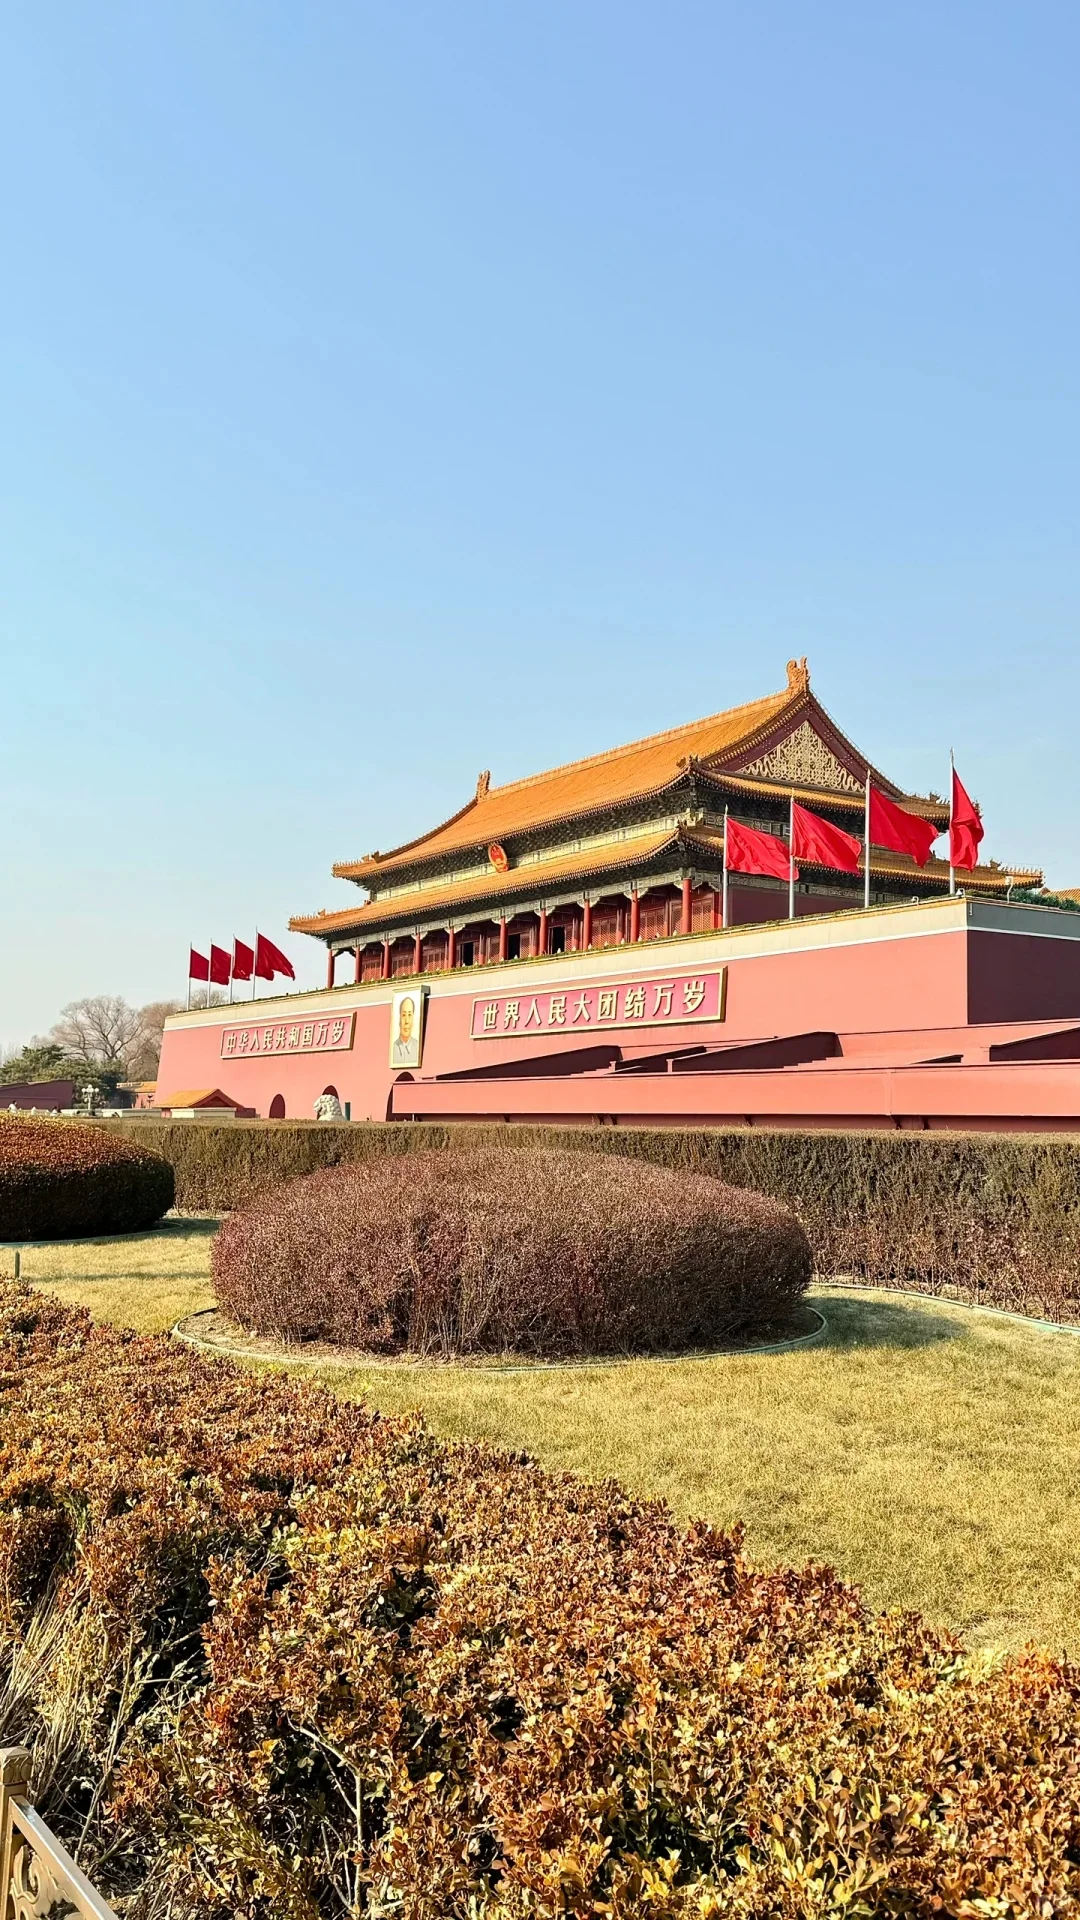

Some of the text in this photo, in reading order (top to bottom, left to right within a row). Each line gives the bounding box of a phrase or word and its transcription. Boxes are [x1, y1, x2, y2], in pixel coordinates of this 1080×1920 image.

[482, 980, 706, 1031] 世界人民大团结万岁
[226, 1020, 345, 1053] 中华人民共和国万岁
